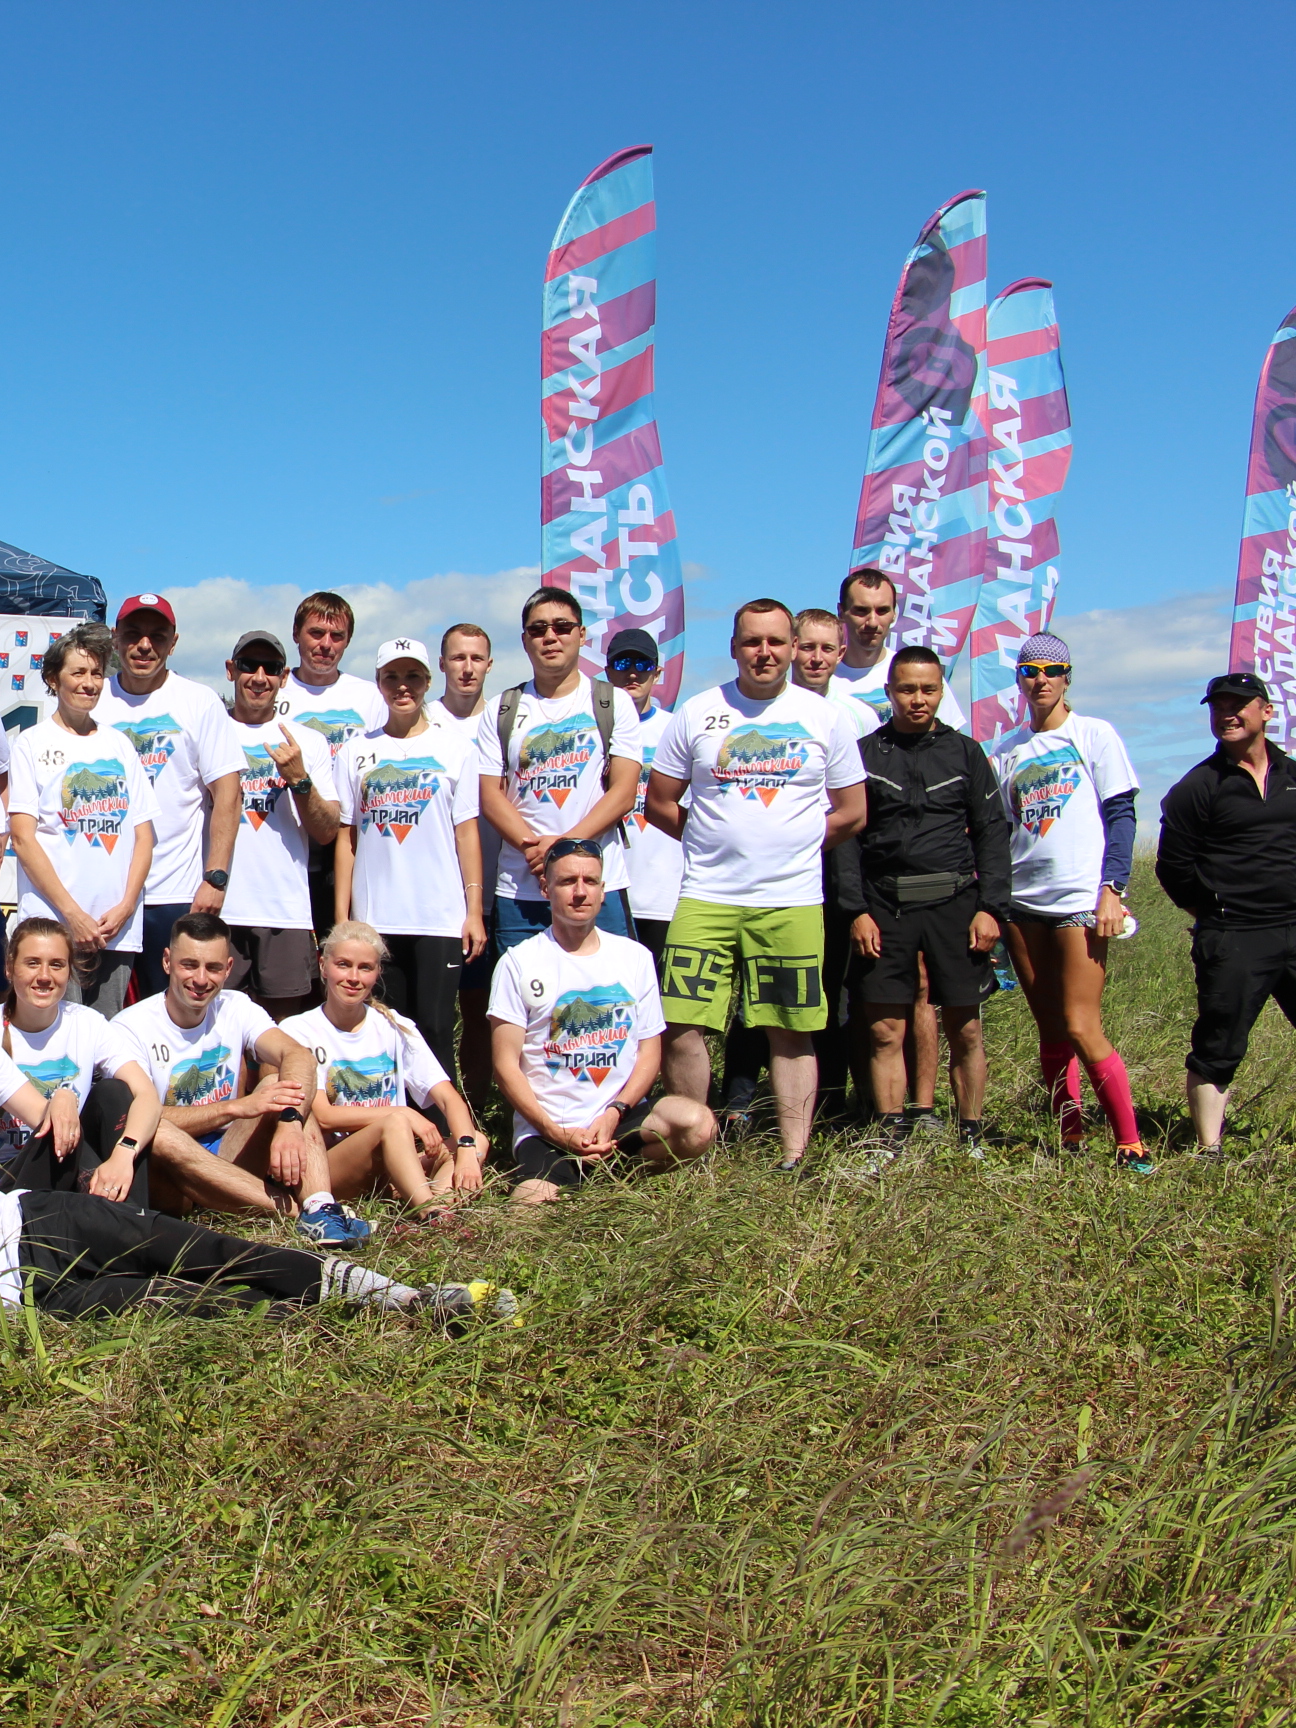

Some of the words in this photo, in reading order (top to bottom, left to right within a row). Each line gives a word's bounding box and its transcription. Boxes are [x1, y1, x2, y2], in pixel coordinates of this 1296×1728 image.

[902, 406, 952, 649] АДАНСКОЙ
[705, 714, 730, 730] 25
[356, 753, 376, 770] 21
[1003, 755, 1018, 774] 17
[370, 809, 419, 826] ТРИАЛ
[1021, 804, 1061, 822] РИАЛ
[530, 979, 544, 997] 9
[544, 1025, 628, 1058] Колымский
[152, 1043, 170, 1062] 10
[563, 1052, 617, 1067] ТРИАЛ
